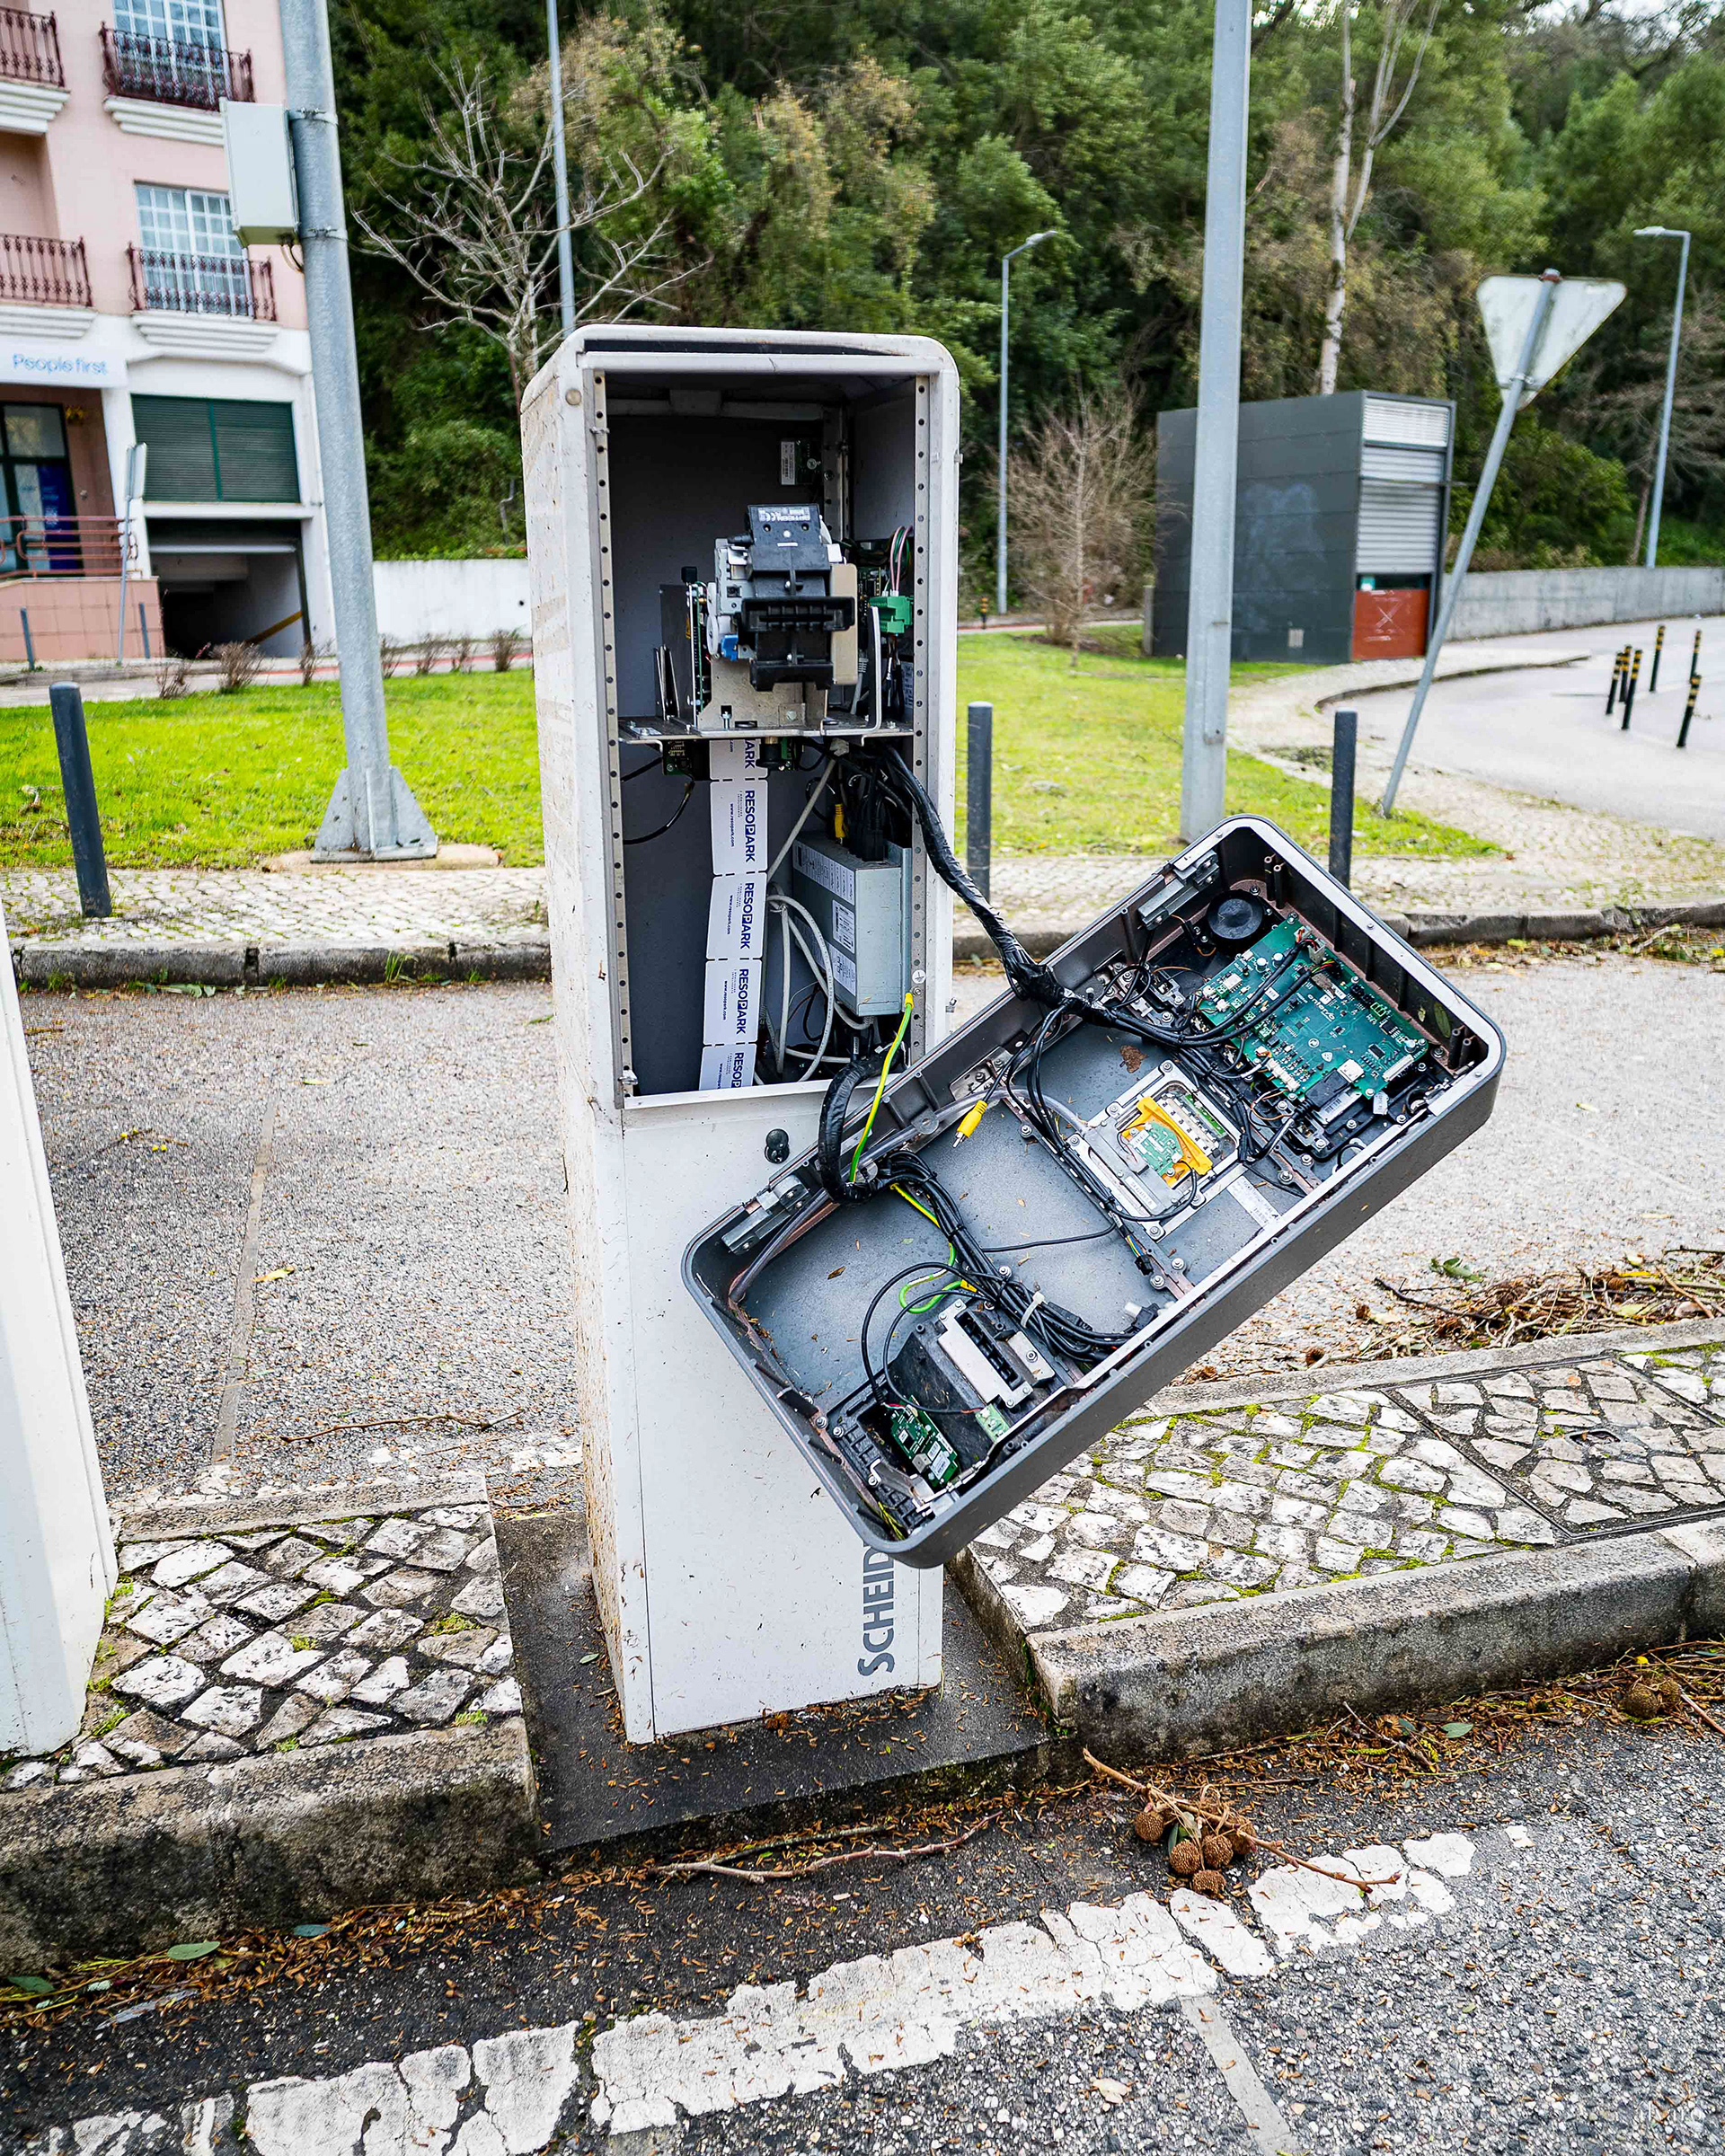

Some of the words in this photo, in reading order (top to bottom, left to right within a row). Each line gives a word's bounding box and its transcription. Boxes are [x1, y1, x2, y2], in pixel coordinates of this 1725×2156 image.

[13, 353, 73, 374] People
[75, 358, 107, 375] first
[745, 790, 756, 862] RESOPARK
[740, 882, 755, 950] RESOPARK
[736, 968, 749, 1035] RESOPARK
[730, 1052, 744, 1089] RESOP
[857, 1542, 895, 1677] SCHEID
